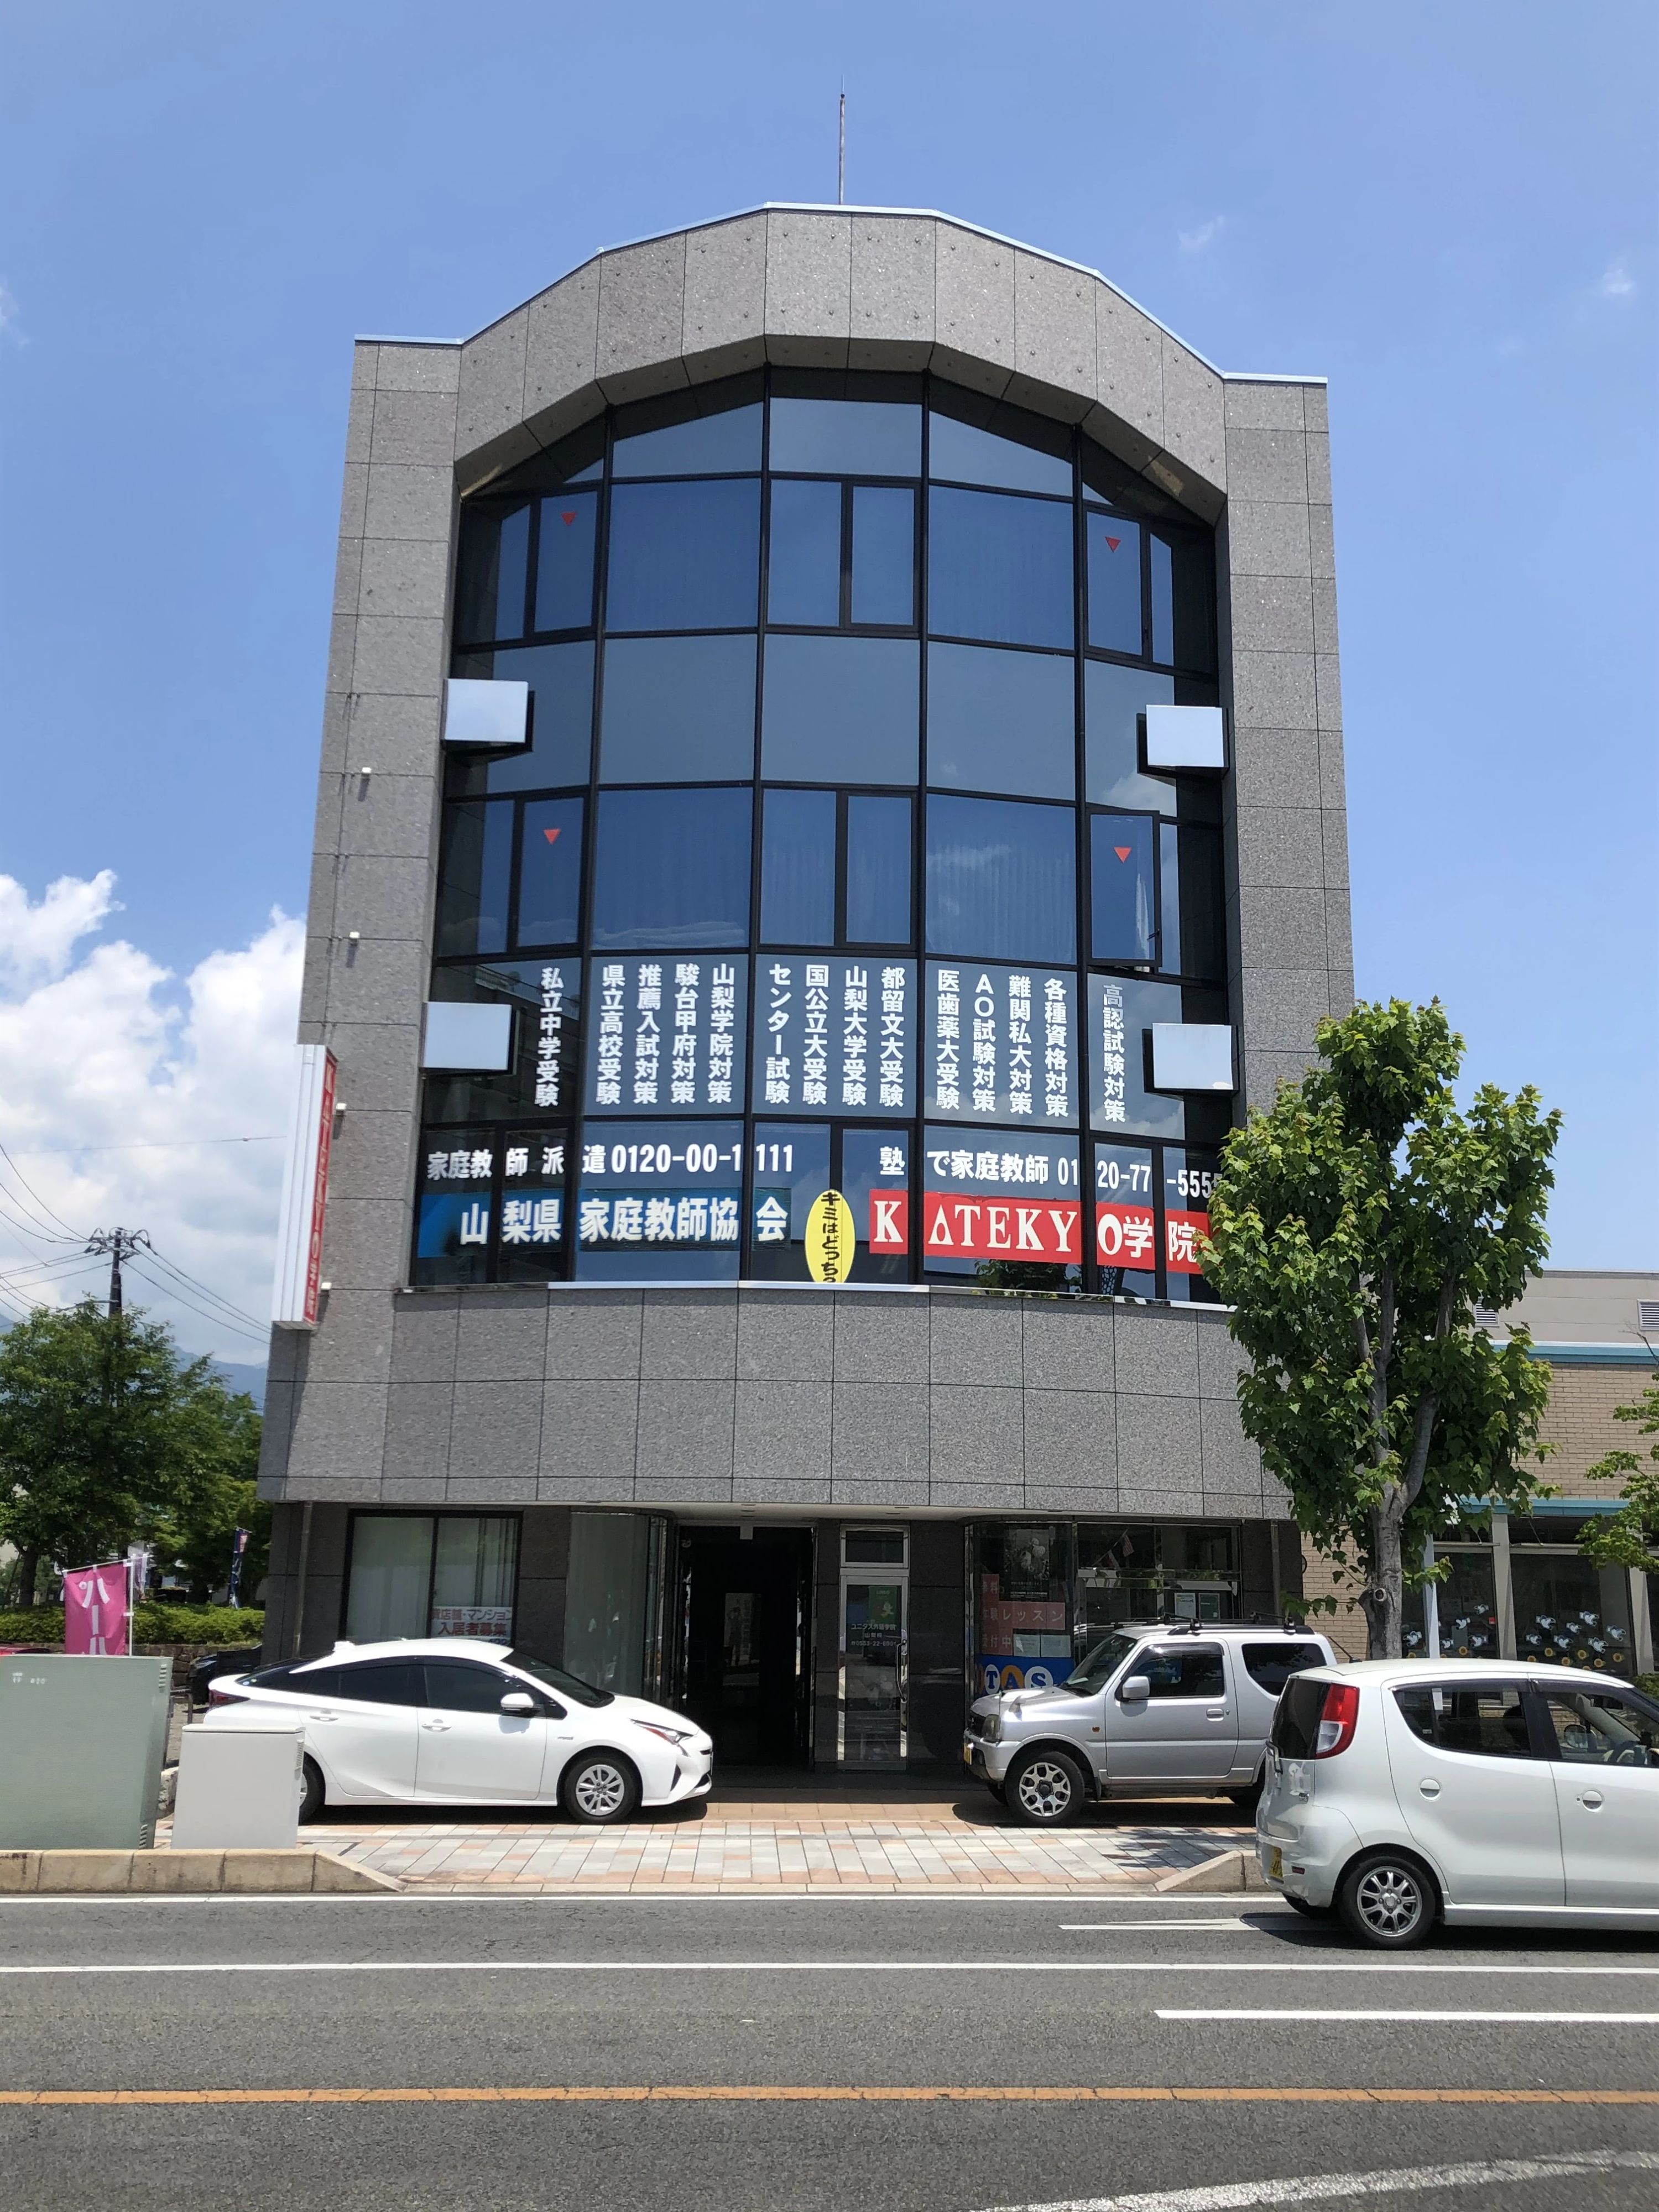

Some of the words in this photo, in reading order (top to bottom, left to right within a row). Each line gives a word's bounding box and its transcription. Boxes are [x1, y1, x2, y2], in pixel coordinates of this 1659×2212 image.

[535, 967, 563, 1107] 私立中学受験
[596, 965, 625, 1105] 県立高校受験
[634, 964, 662, 1104] 推薦入試対策
[671, 963, 700, 1104] 駿台甲府対策
[708, 963, 735, 1103] 山梨学院対策
[765, 964, 791, 1104] センター試験
[802, 964, 830, 1105] 国公立大受験
[842, 966, 868, 1106] 山梨大学受験
[879, 967, 905, 1107] 都留文大受験
[936, 969, 961, 1110] 医歯薬大受験
[1009, 975, 1033, 1114] 難関私大対策
[1044, 978, 1069, 1118] 各種資格対策
[1103, 984, 1126, 1123] 高認試験対策
[460, 1196, 788, 1244] 山梨県家庭教師協会
[879, 1146, 1049, 1185] 塾で家庭教師
[438, 1621, 507, 1636] 入居者募集
